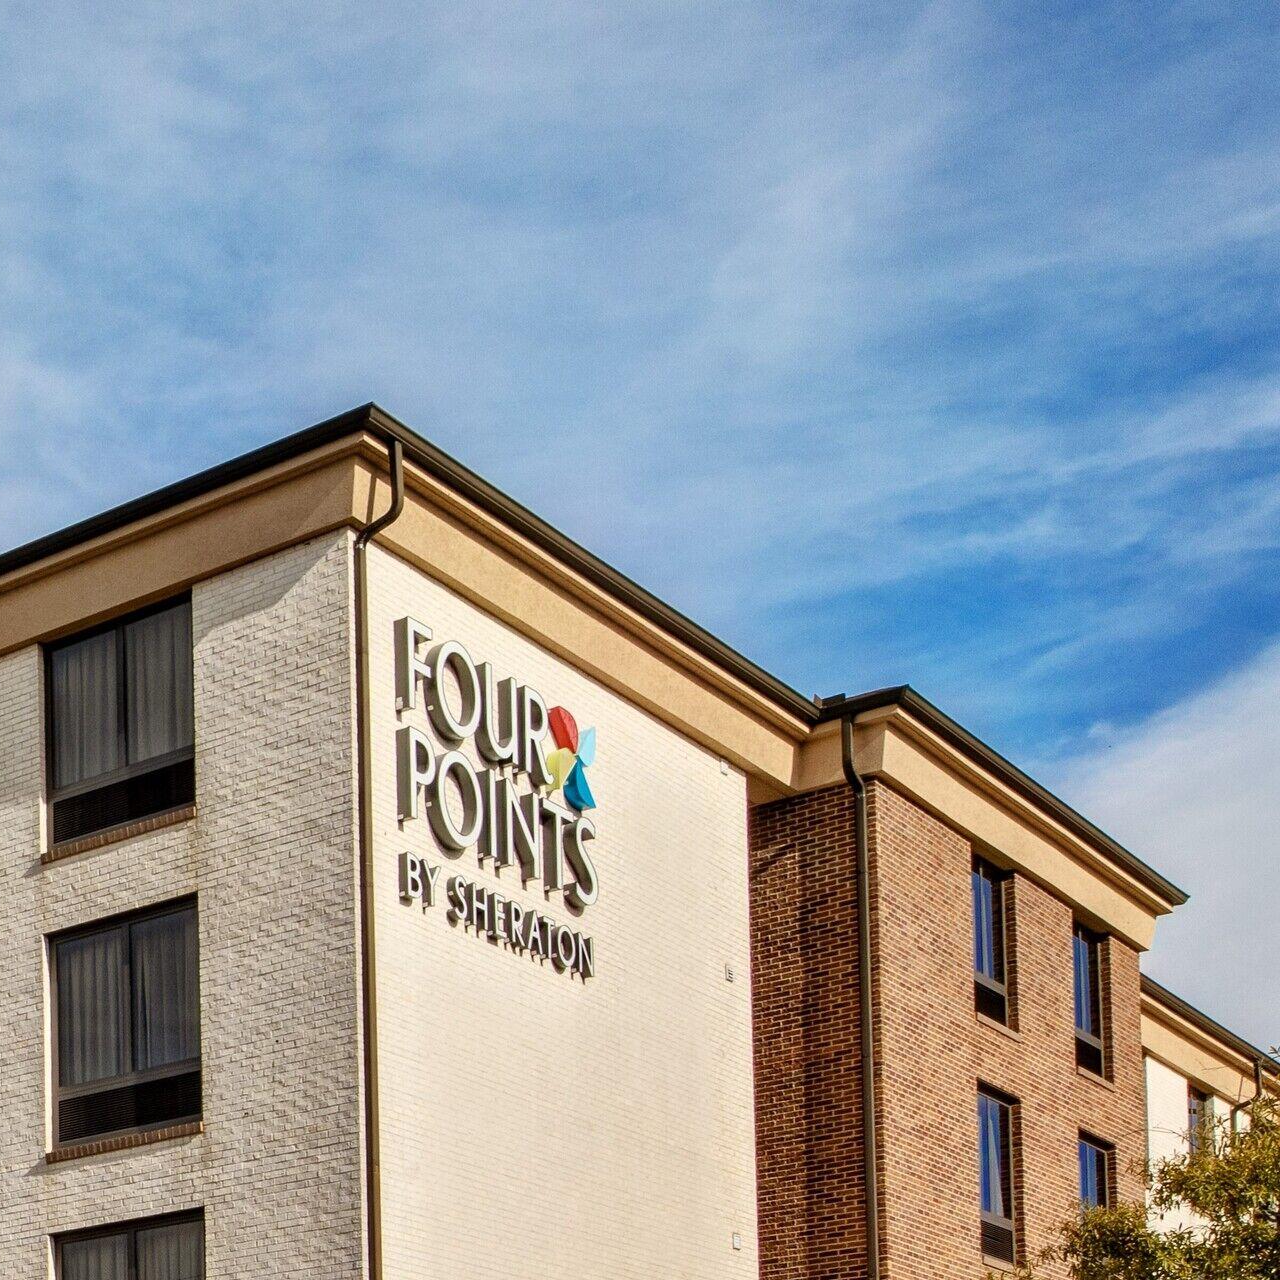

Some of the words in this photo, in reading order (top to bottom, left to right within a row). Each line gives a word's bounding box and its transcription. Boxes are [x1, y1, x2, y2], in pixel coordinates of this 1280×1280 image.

[393, 616, 554, 787] FOUR
[395, 726, 598, 908] POINTS
[398, 851, 440, 908] BY
[447, 875, 595, 978] SHERATON
